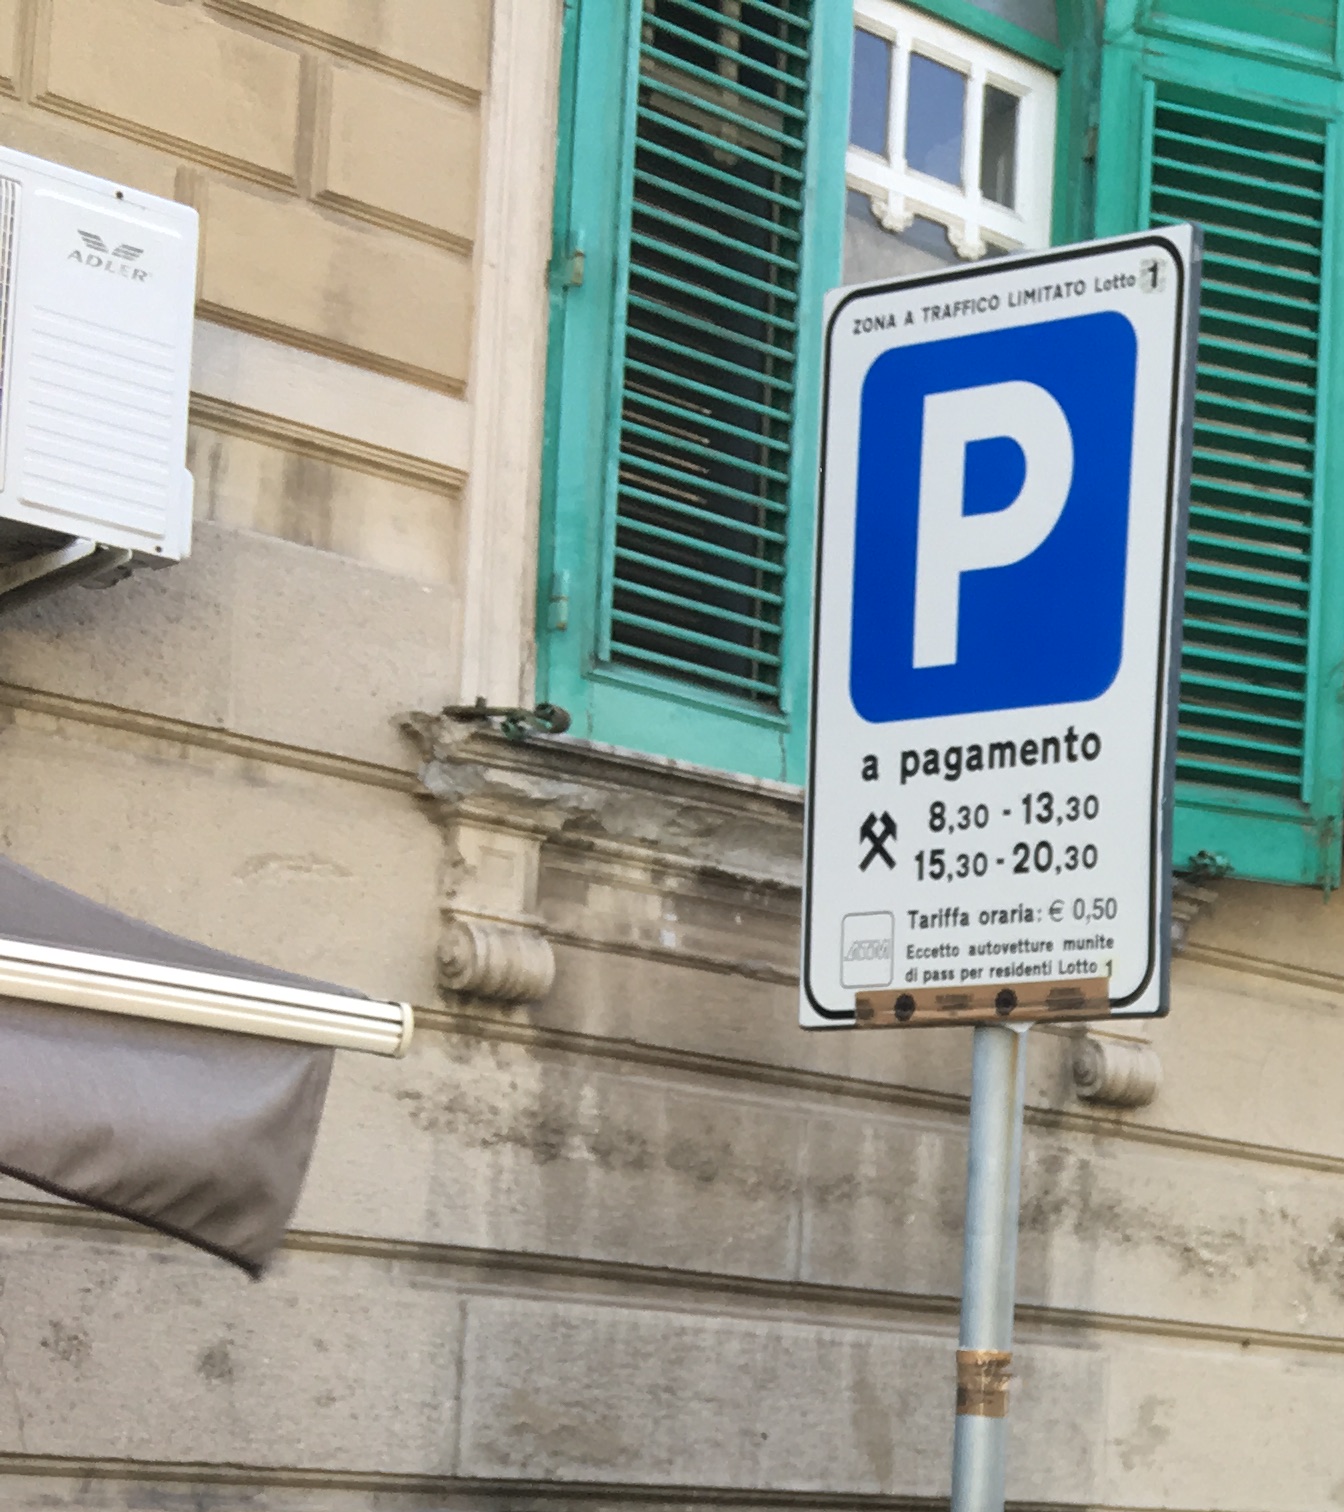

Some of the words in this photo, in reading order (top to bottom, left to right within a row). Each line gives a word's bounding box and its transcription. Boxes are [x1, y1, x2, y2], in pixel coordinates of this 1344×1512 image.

[67, 249, 149, 283] ADLER
[852, 315, 896, 335] ZONA
[904, 311, 914, 325] A
[921, 294, 1000, 323] TRAFFICO
[1008, 279, 1086, 308] LIMITATO
[1094, 272, 1136, 293] Lotto
[1147, 262, 1159, 289] 1
[912, 380, 1074, 669] P
[861, 754, 879, 782] a
[900, 726, 1101, 785] pagamento
[929, 800, 989, 834] 8,30
[1022, 791, 1100, 826] 13,30
[914, 849, 988, 882] 15,30
[1012, 840, 1098, 874] 20,30
[907, 907, 970, 930] Tariffa
[978, 903, 1042, 926] oraria:
[1072, 897, 1118, 925] 0,50
[906, 943, 960, 960] Eccetto
[968, 938, 1054, 957] autovetture
[1062, 934, 1115, 951] munite
[905, 967, 918, 983] di
[923, 968, 955, 984] pass
[960, 966, 984, 982] per
[989, 959, 1052, 979] residenti
[1058, 959, 1098, 976] Lotto
[1105, 959, 1113, 977] 1
